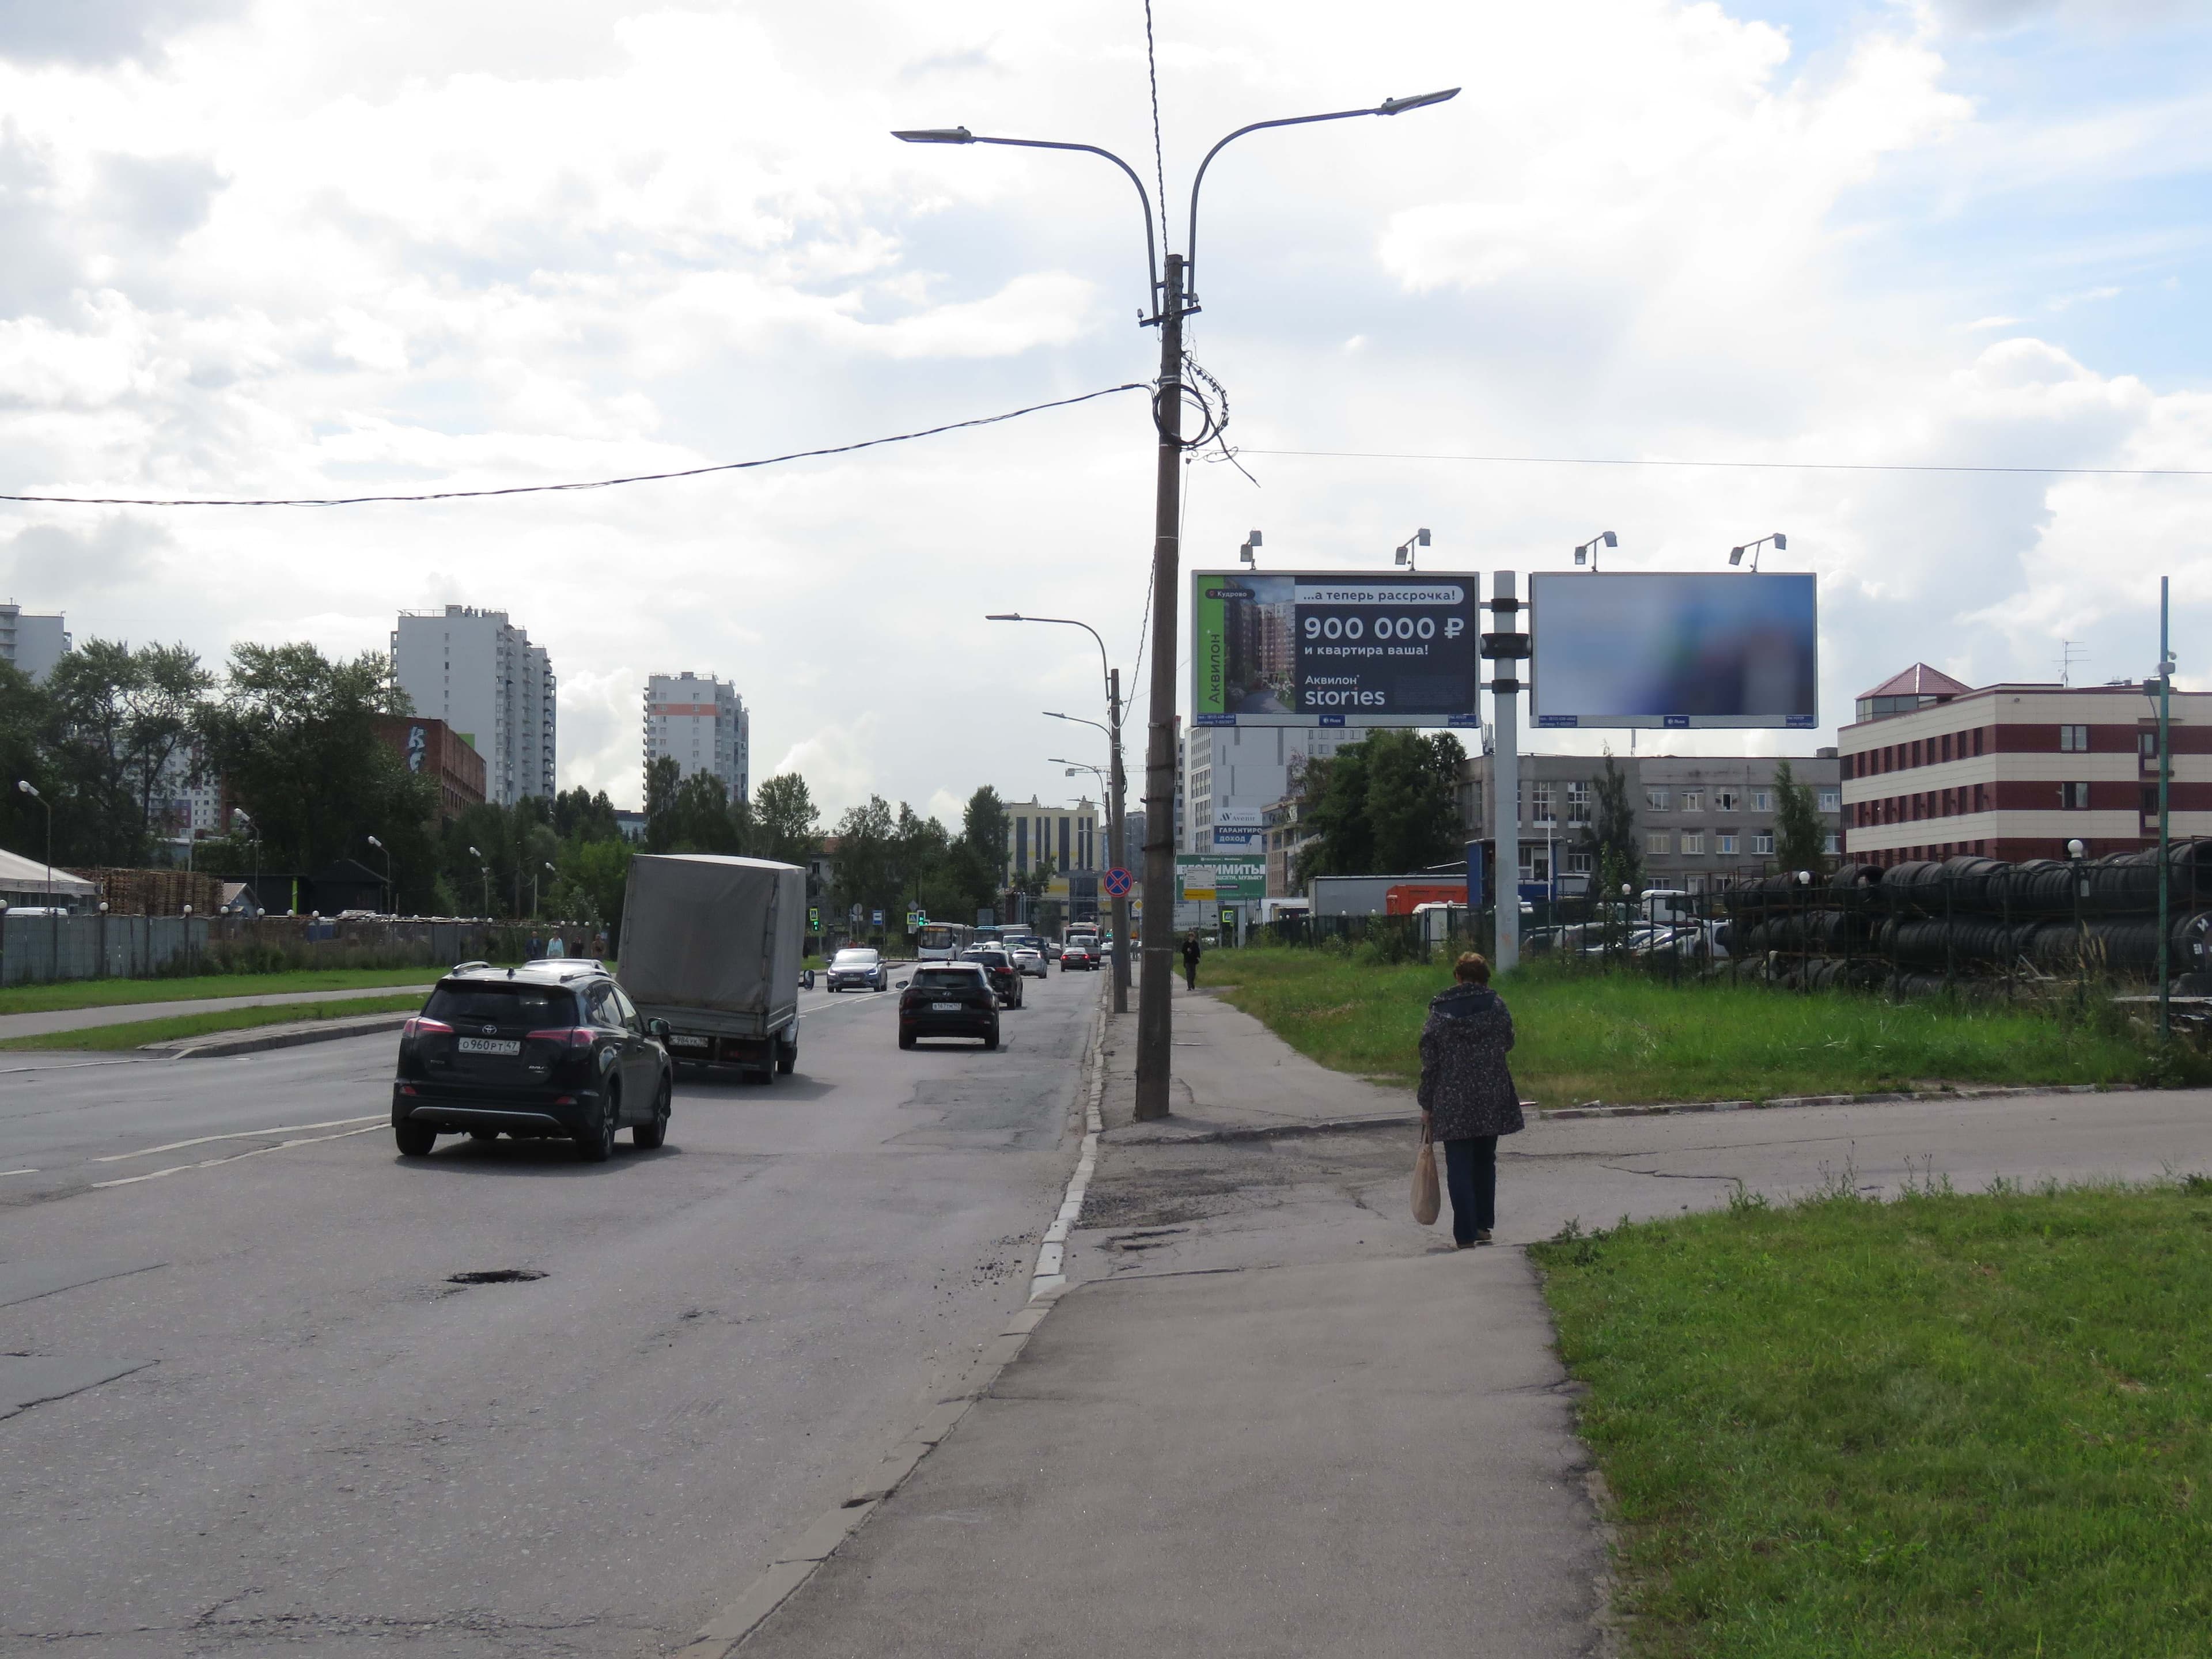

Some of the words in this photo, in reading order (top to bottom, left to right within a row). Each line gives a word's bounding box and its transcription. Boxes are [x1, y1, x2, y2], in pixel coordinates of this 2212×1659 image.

[1327, 592, 1374, 602] теперь
[1378, 590, 1455, 602] рассрочка!
[1304, 617, 1363, 639] 900
[1374, 617, 1435, 639] 000
[1304, 646, 1313, 654] и
[1317, 646, 1384, 657] квартира
[1388, 645, 1429, 655] ваша!
[1305, 675, 1357, 685] Аквилон
[1305, 686, 1385, 706] stories
[1176, 864, 1266, 874] БИМИТЫ
